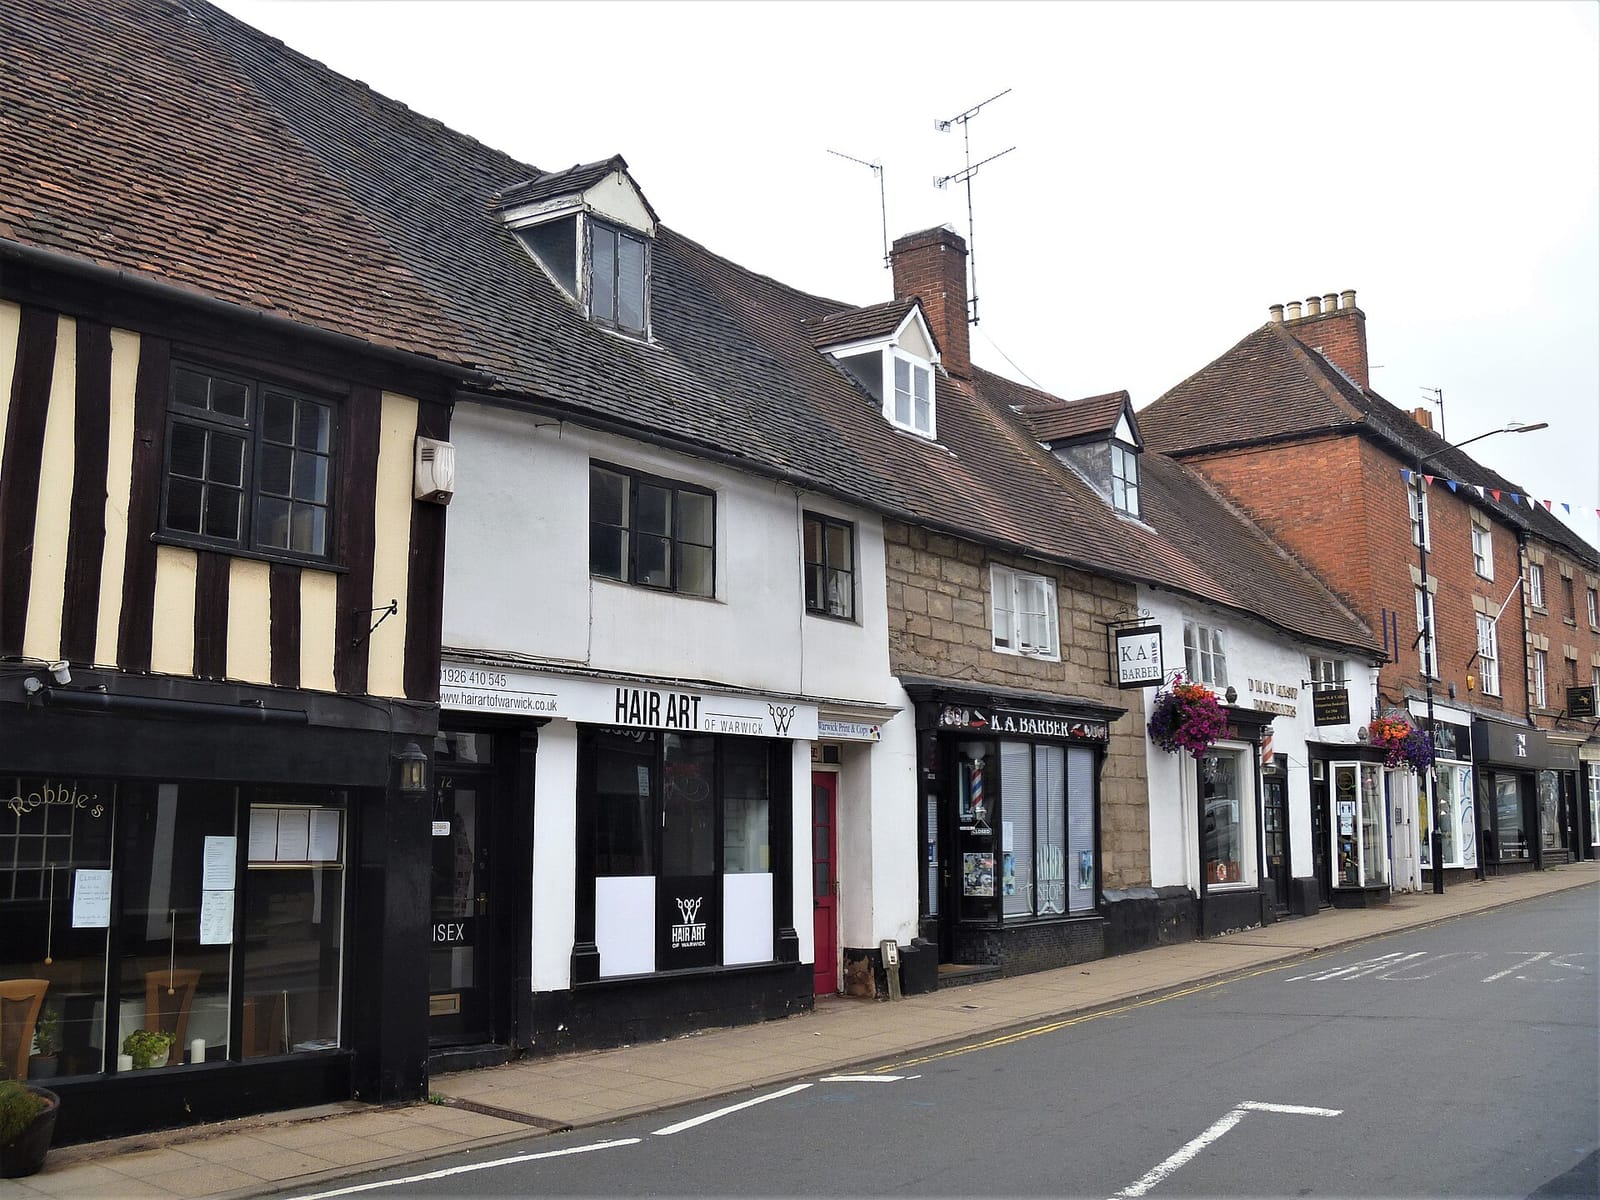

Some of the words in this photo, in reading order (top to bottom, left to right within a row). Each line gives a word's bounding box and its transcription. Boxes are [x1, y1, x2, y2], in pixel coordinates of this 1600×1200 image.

[440, 669, 466, 683] 1926
[469, 671, 486, 685] 410
[488, 673, 507, 687] 545
[1122, 667, 1159, 680] BARBER
[615, 687, 661, 727] HAIR
[665, 692, 701, 729] ART
[704, 718, 716, 731] OF
[720, 719, 763, 734] WARWICK
[1019, 717, 1069, 737] BARBER
[8, 783, 104, 817] Robbie's
[672, 927, 690, 942] HAIR
[691, 926, 706, 941] ART
